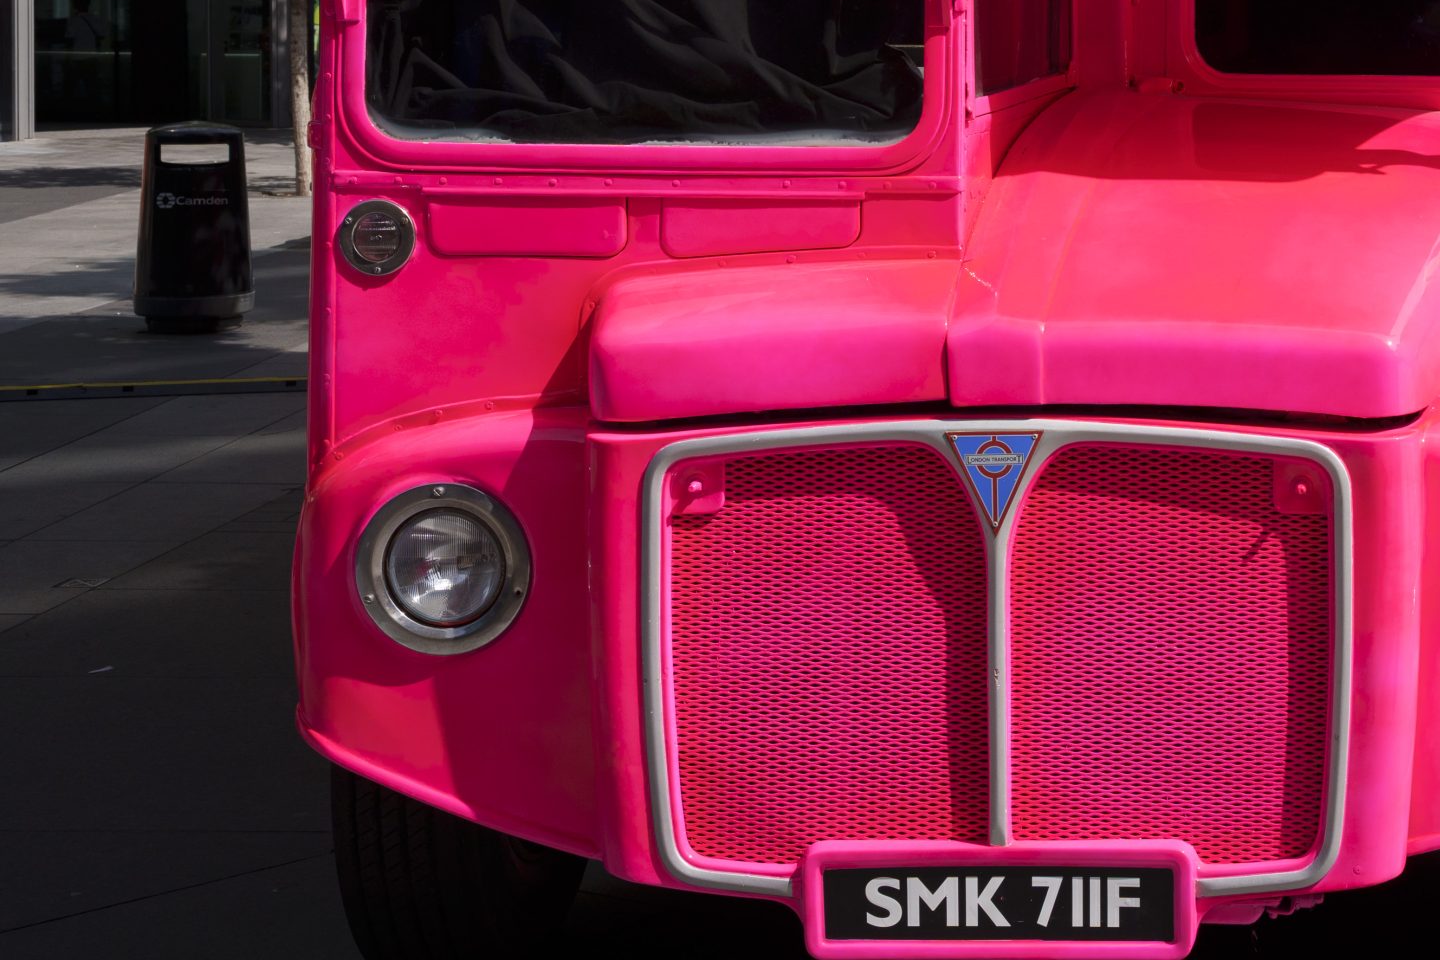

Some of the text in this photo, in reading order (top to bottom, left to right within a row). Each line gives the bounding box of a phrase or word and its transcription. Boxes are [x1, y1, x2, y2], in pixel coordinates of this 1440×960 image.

[175, 195, 228, 206] Camden
[966, 455, 1021, 464] LONDON TRANSPORT
[864, 875, 1141, 929] SMK 711F
